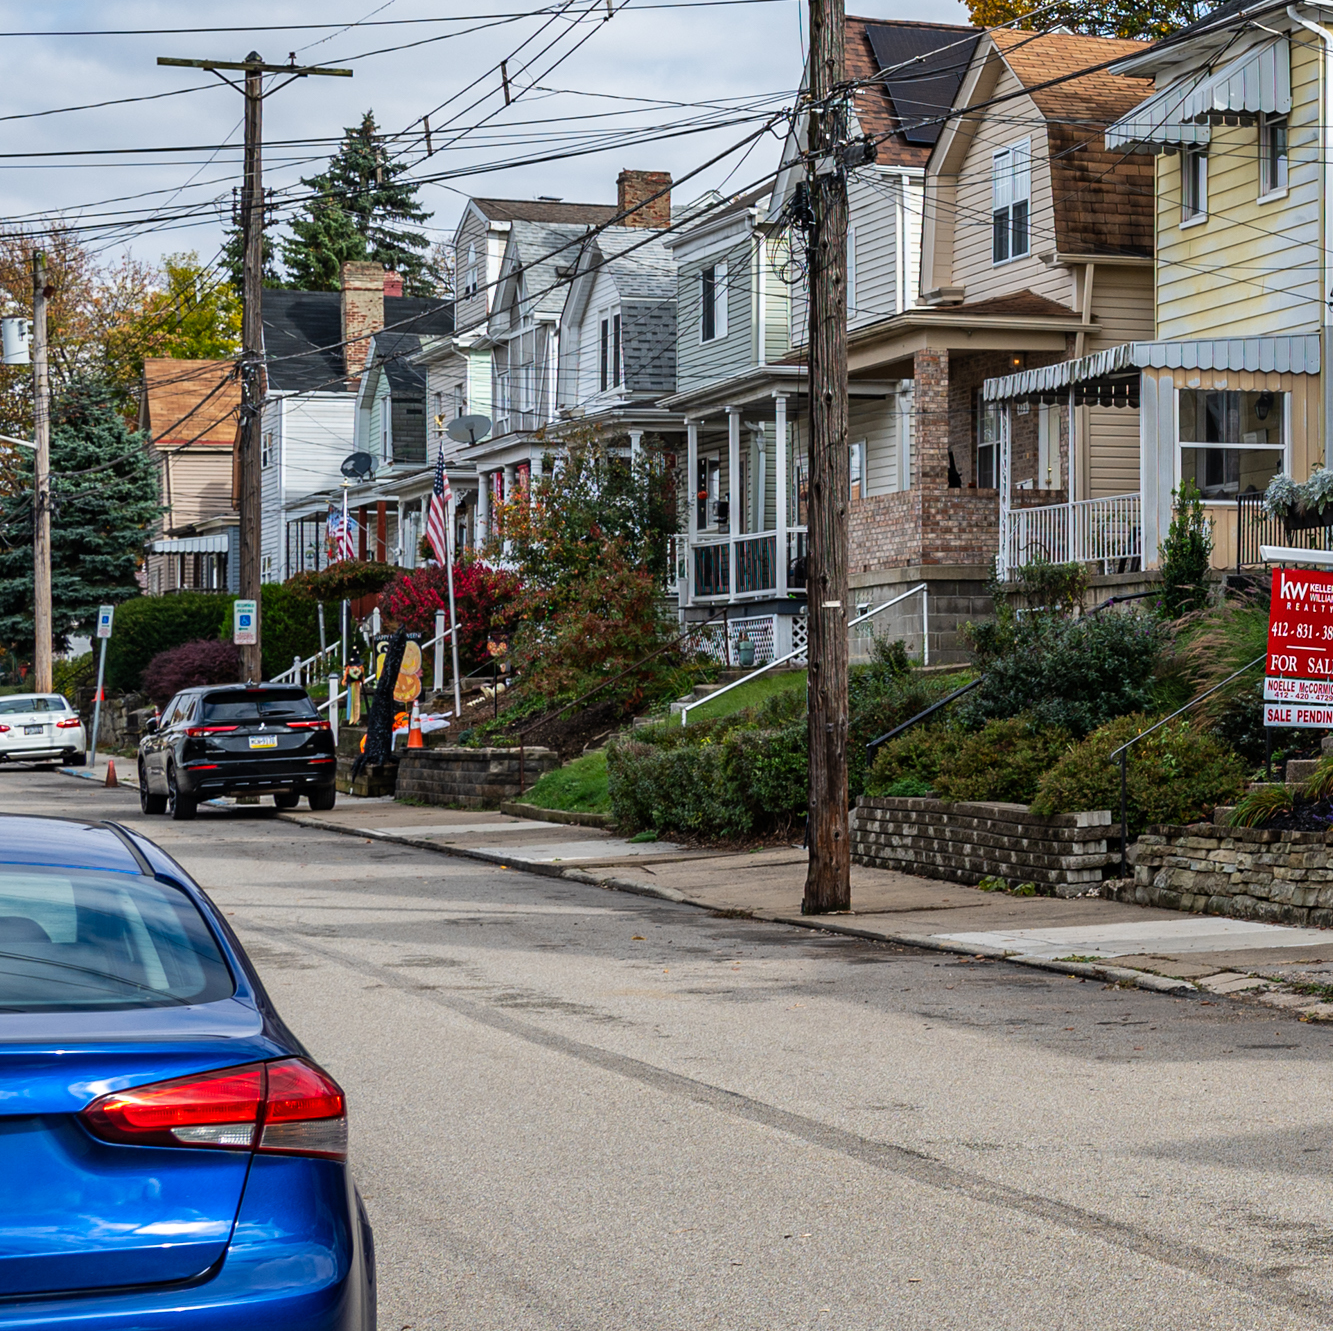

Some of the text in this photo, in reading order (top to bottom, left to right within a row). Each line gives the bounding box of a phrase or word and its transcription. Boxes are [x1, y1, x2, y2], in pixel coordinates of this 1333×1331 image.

[1280, 572, 1309, 601] kw
[1270, 654, 1298, 672] FOR
[1267, 679, 1296, 692] NOELLE
[1267, 708, 1292, 722] SALE
